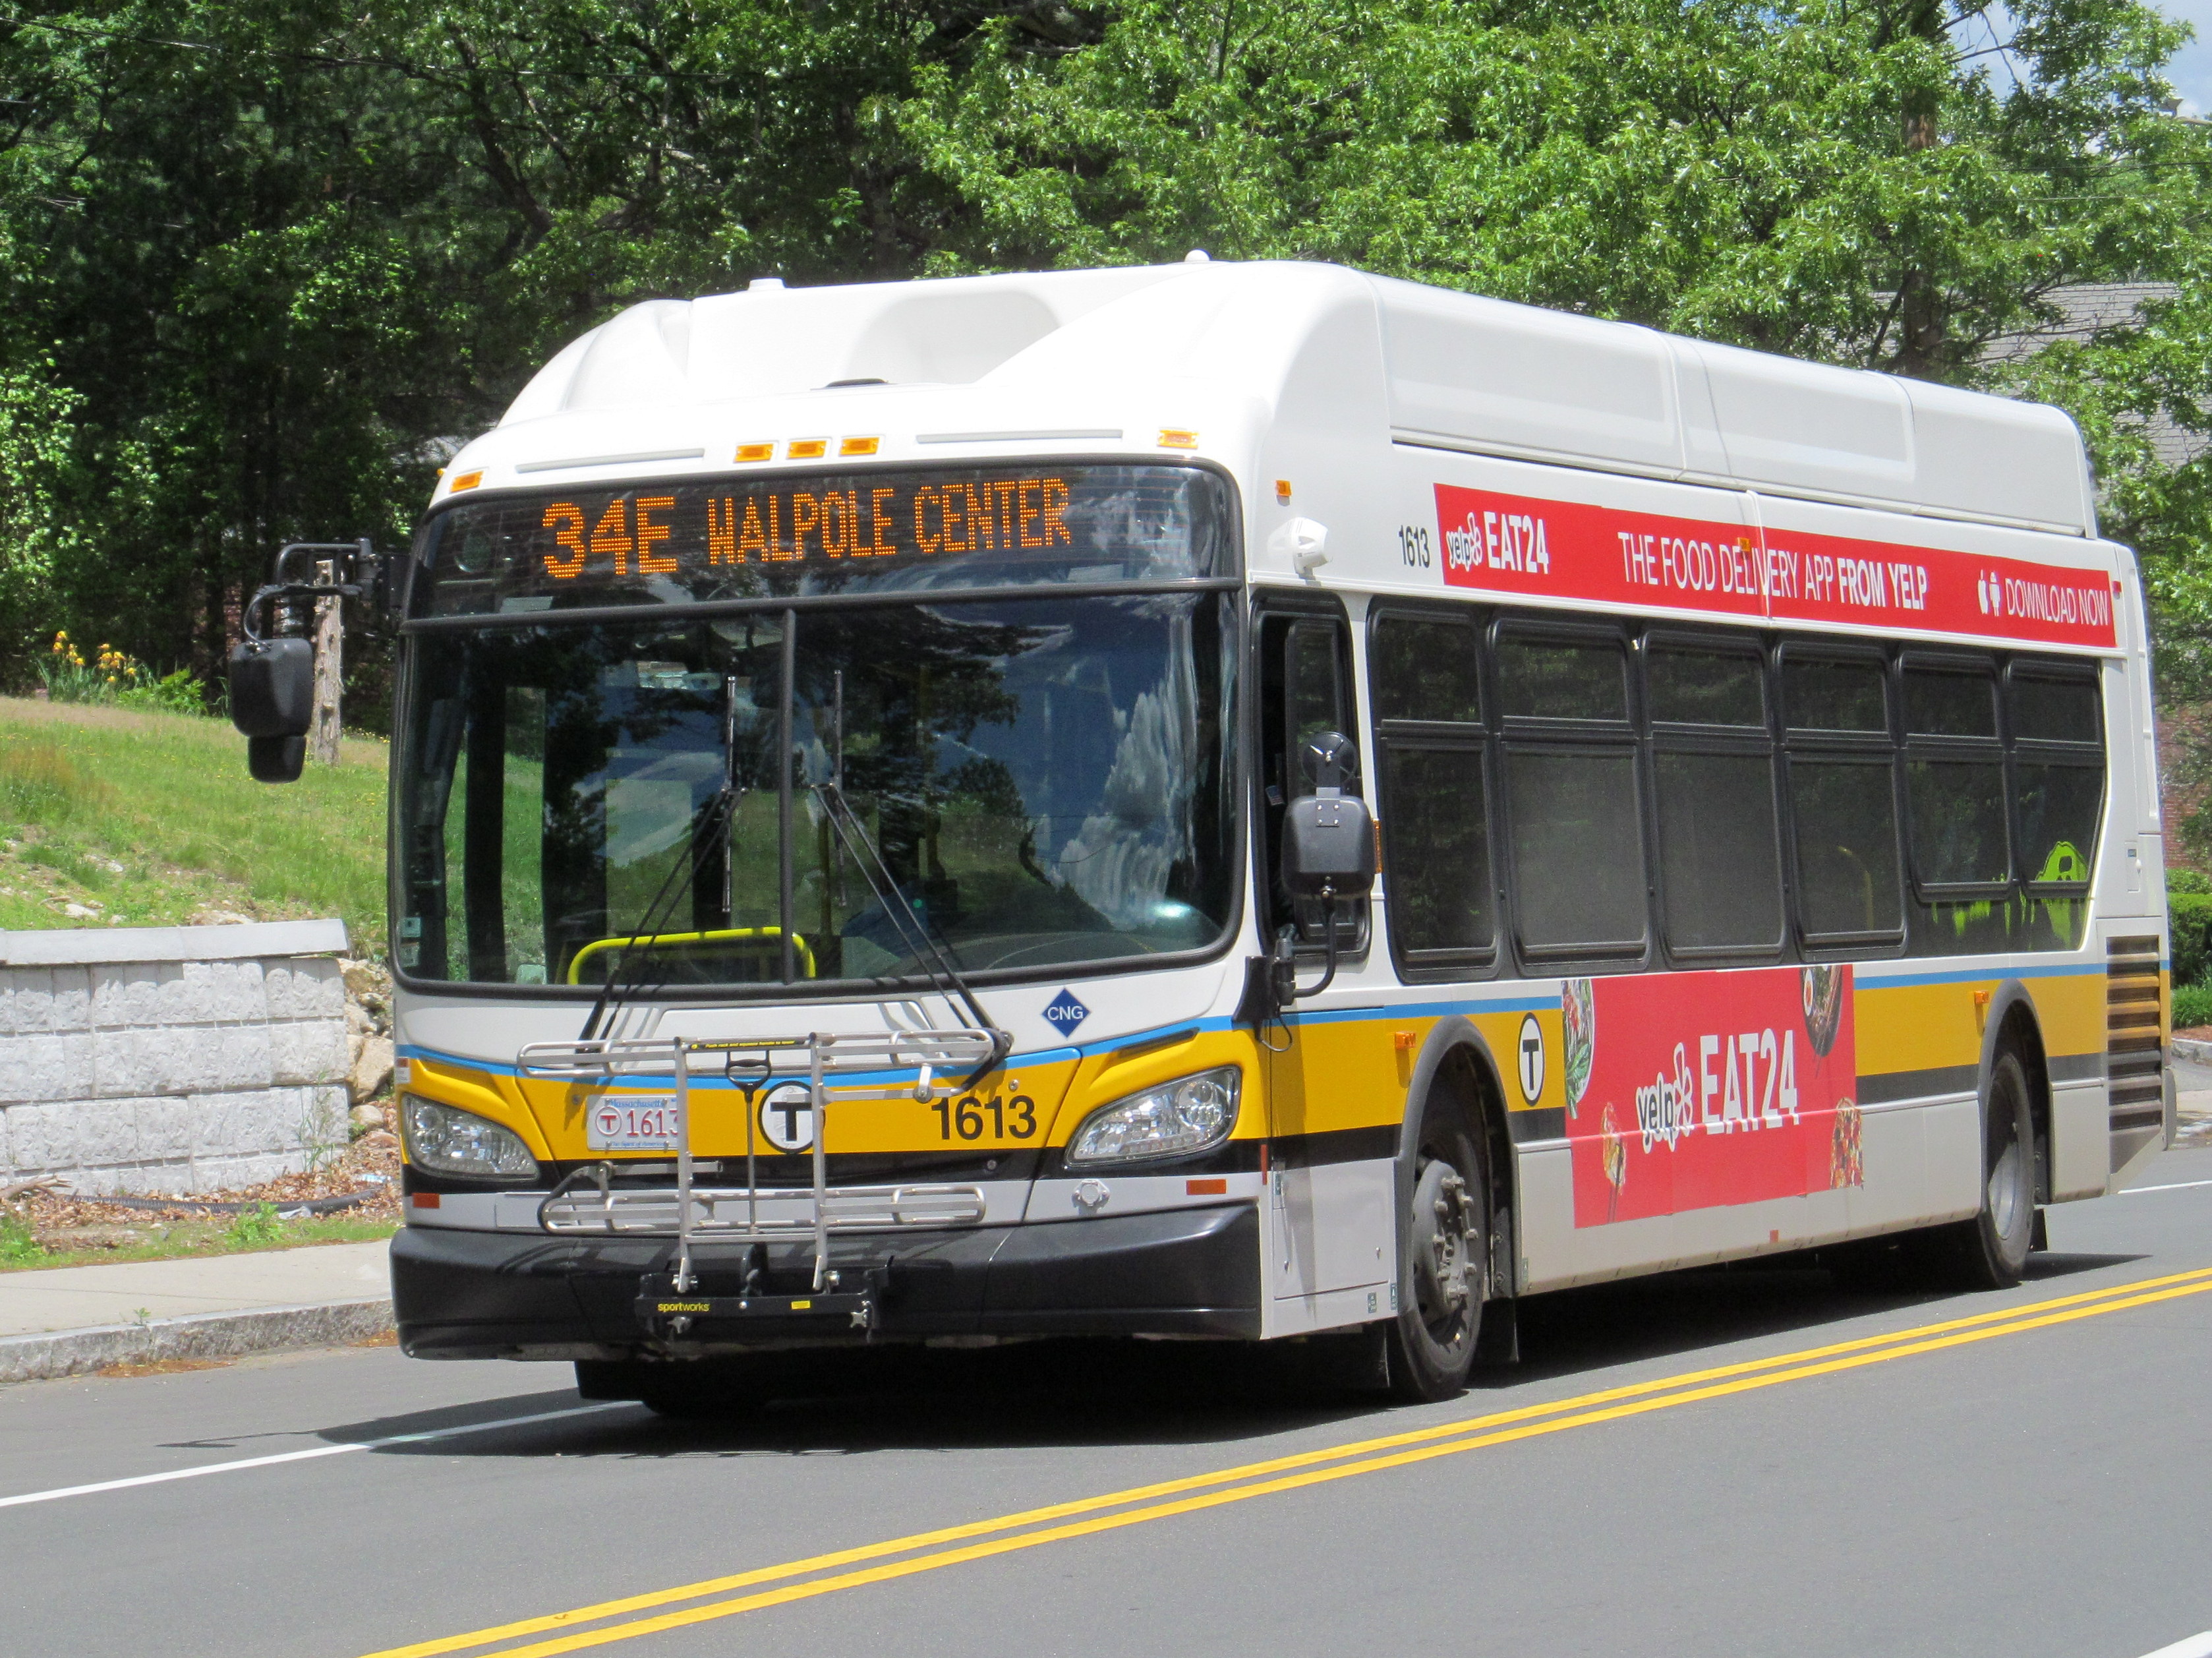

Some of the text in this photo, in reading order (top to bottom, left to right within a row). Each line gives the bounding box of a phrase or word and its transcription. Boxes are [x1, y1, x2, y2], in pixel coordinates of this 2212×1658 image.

[542, 478, 1072, 577] 34E WALPOLE CENTER
[1399, 525, 1430, 568] 1613
[1447, 511, 1549, 574] yelp EAT24
[1617, 532, 1927, 610] THE FOOD DELIVERY APP FROM YELP
[2005, 577, 2109, 626] DOWNLOAD NOW
[1047, 1006, 1084, 1021] CNG
[1523, 1039, 1540, 1091] T
[1637, 1028, 1799, 1153] yelp EAT24
[770, 1102, 813, 1141] T
[932, 1095, 1037, 1140] 1613
[658, 1302, 711, 1313] sportworks
